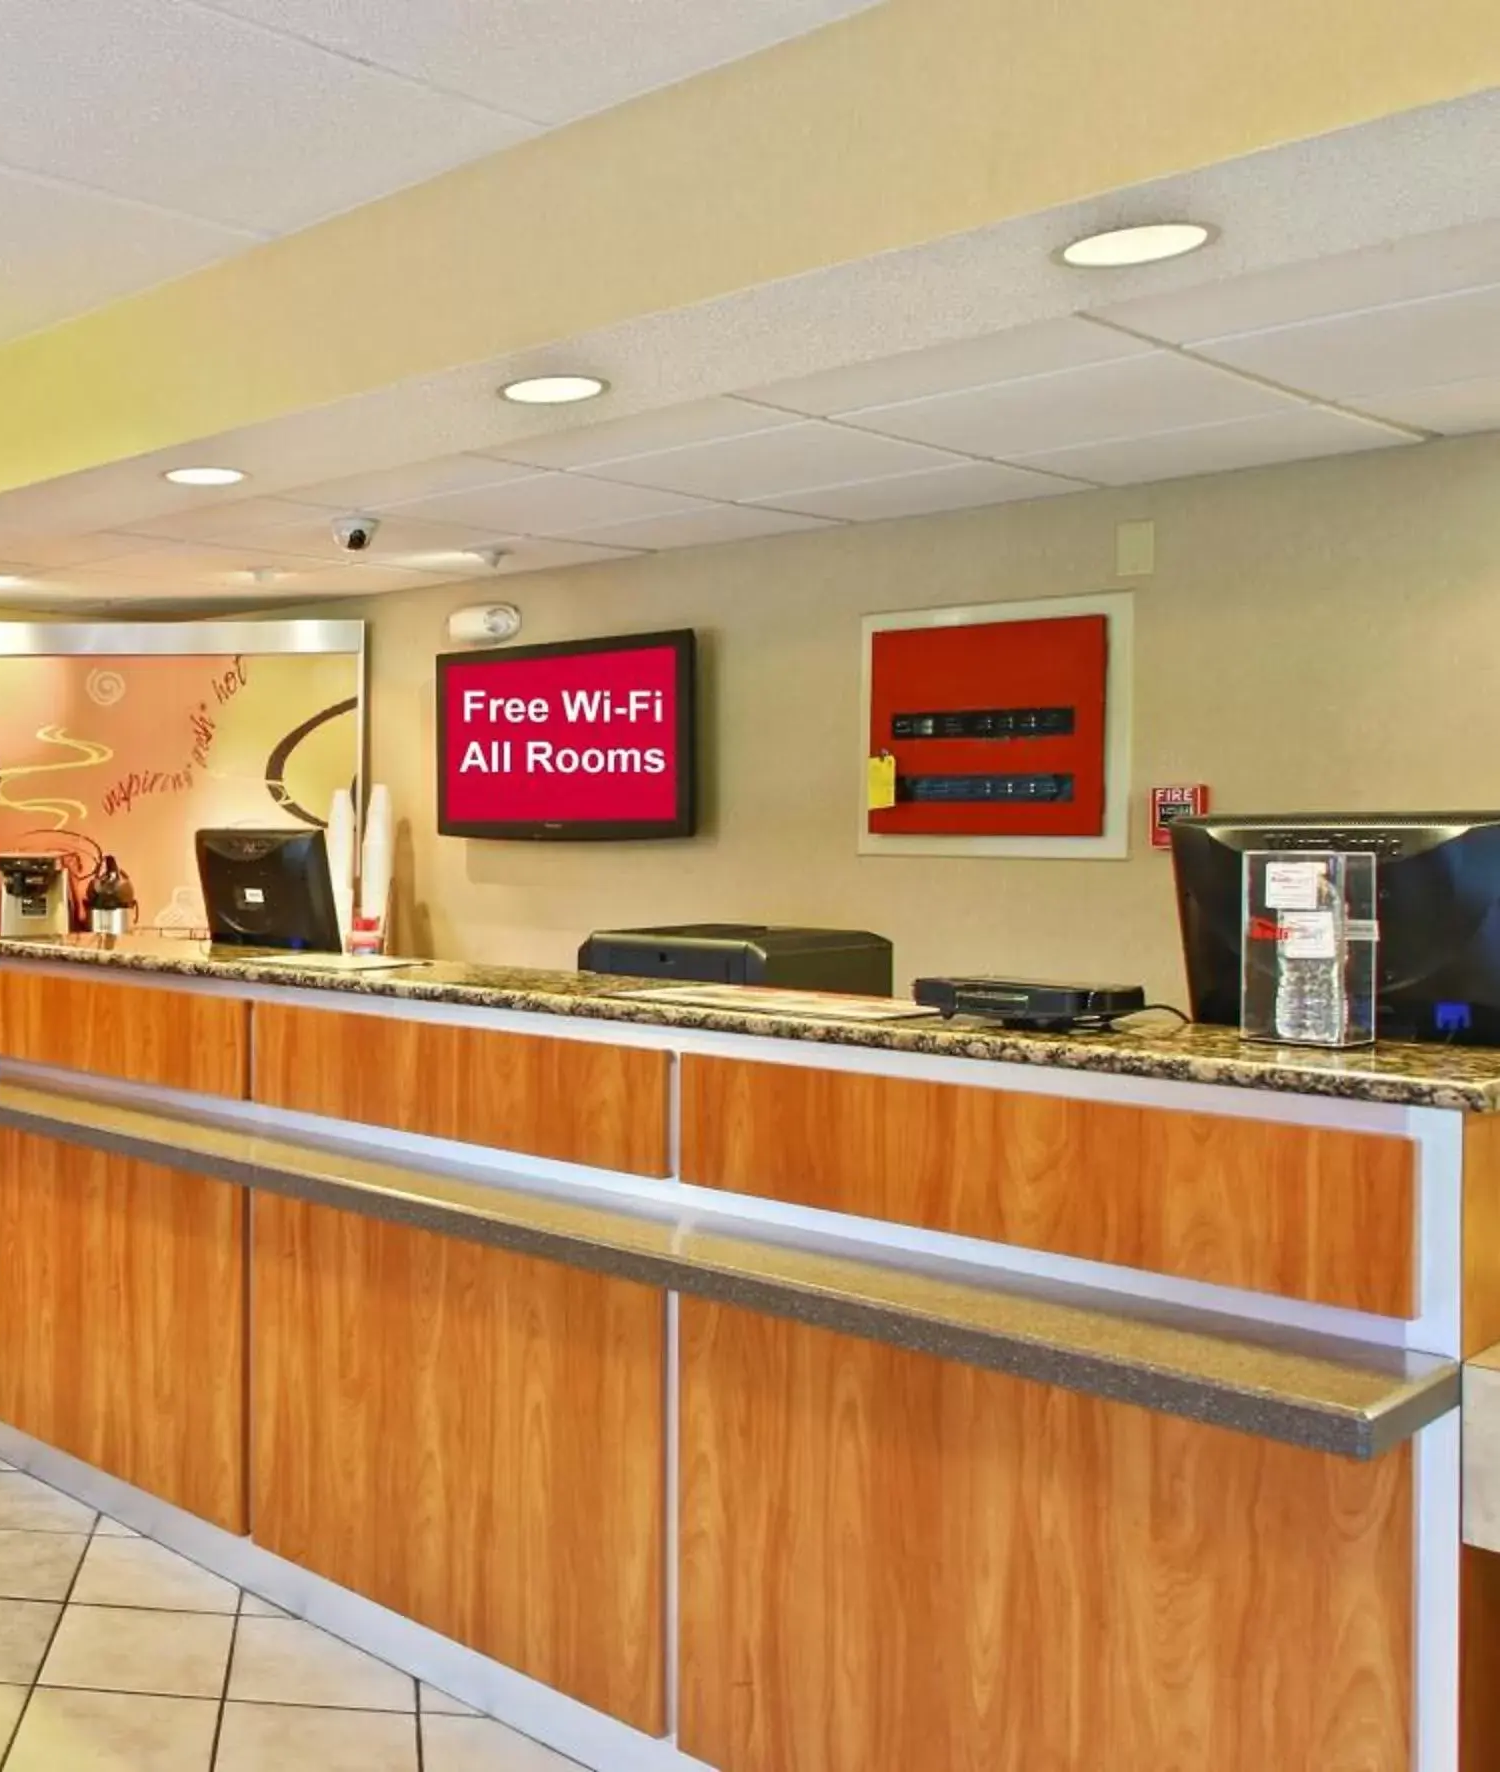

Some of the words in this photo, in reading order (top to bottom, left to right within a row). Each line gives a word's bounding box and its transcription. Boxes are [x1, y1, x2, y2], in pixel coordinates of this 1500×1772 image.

[462, 690, 550, 723] Free
[561, 690, 664, 723] Wi-Fi
[459, 741, 511, 773] All
[526, 741, 666, 774] Rooms
[1155, 788, 1193, 801] FIRE
